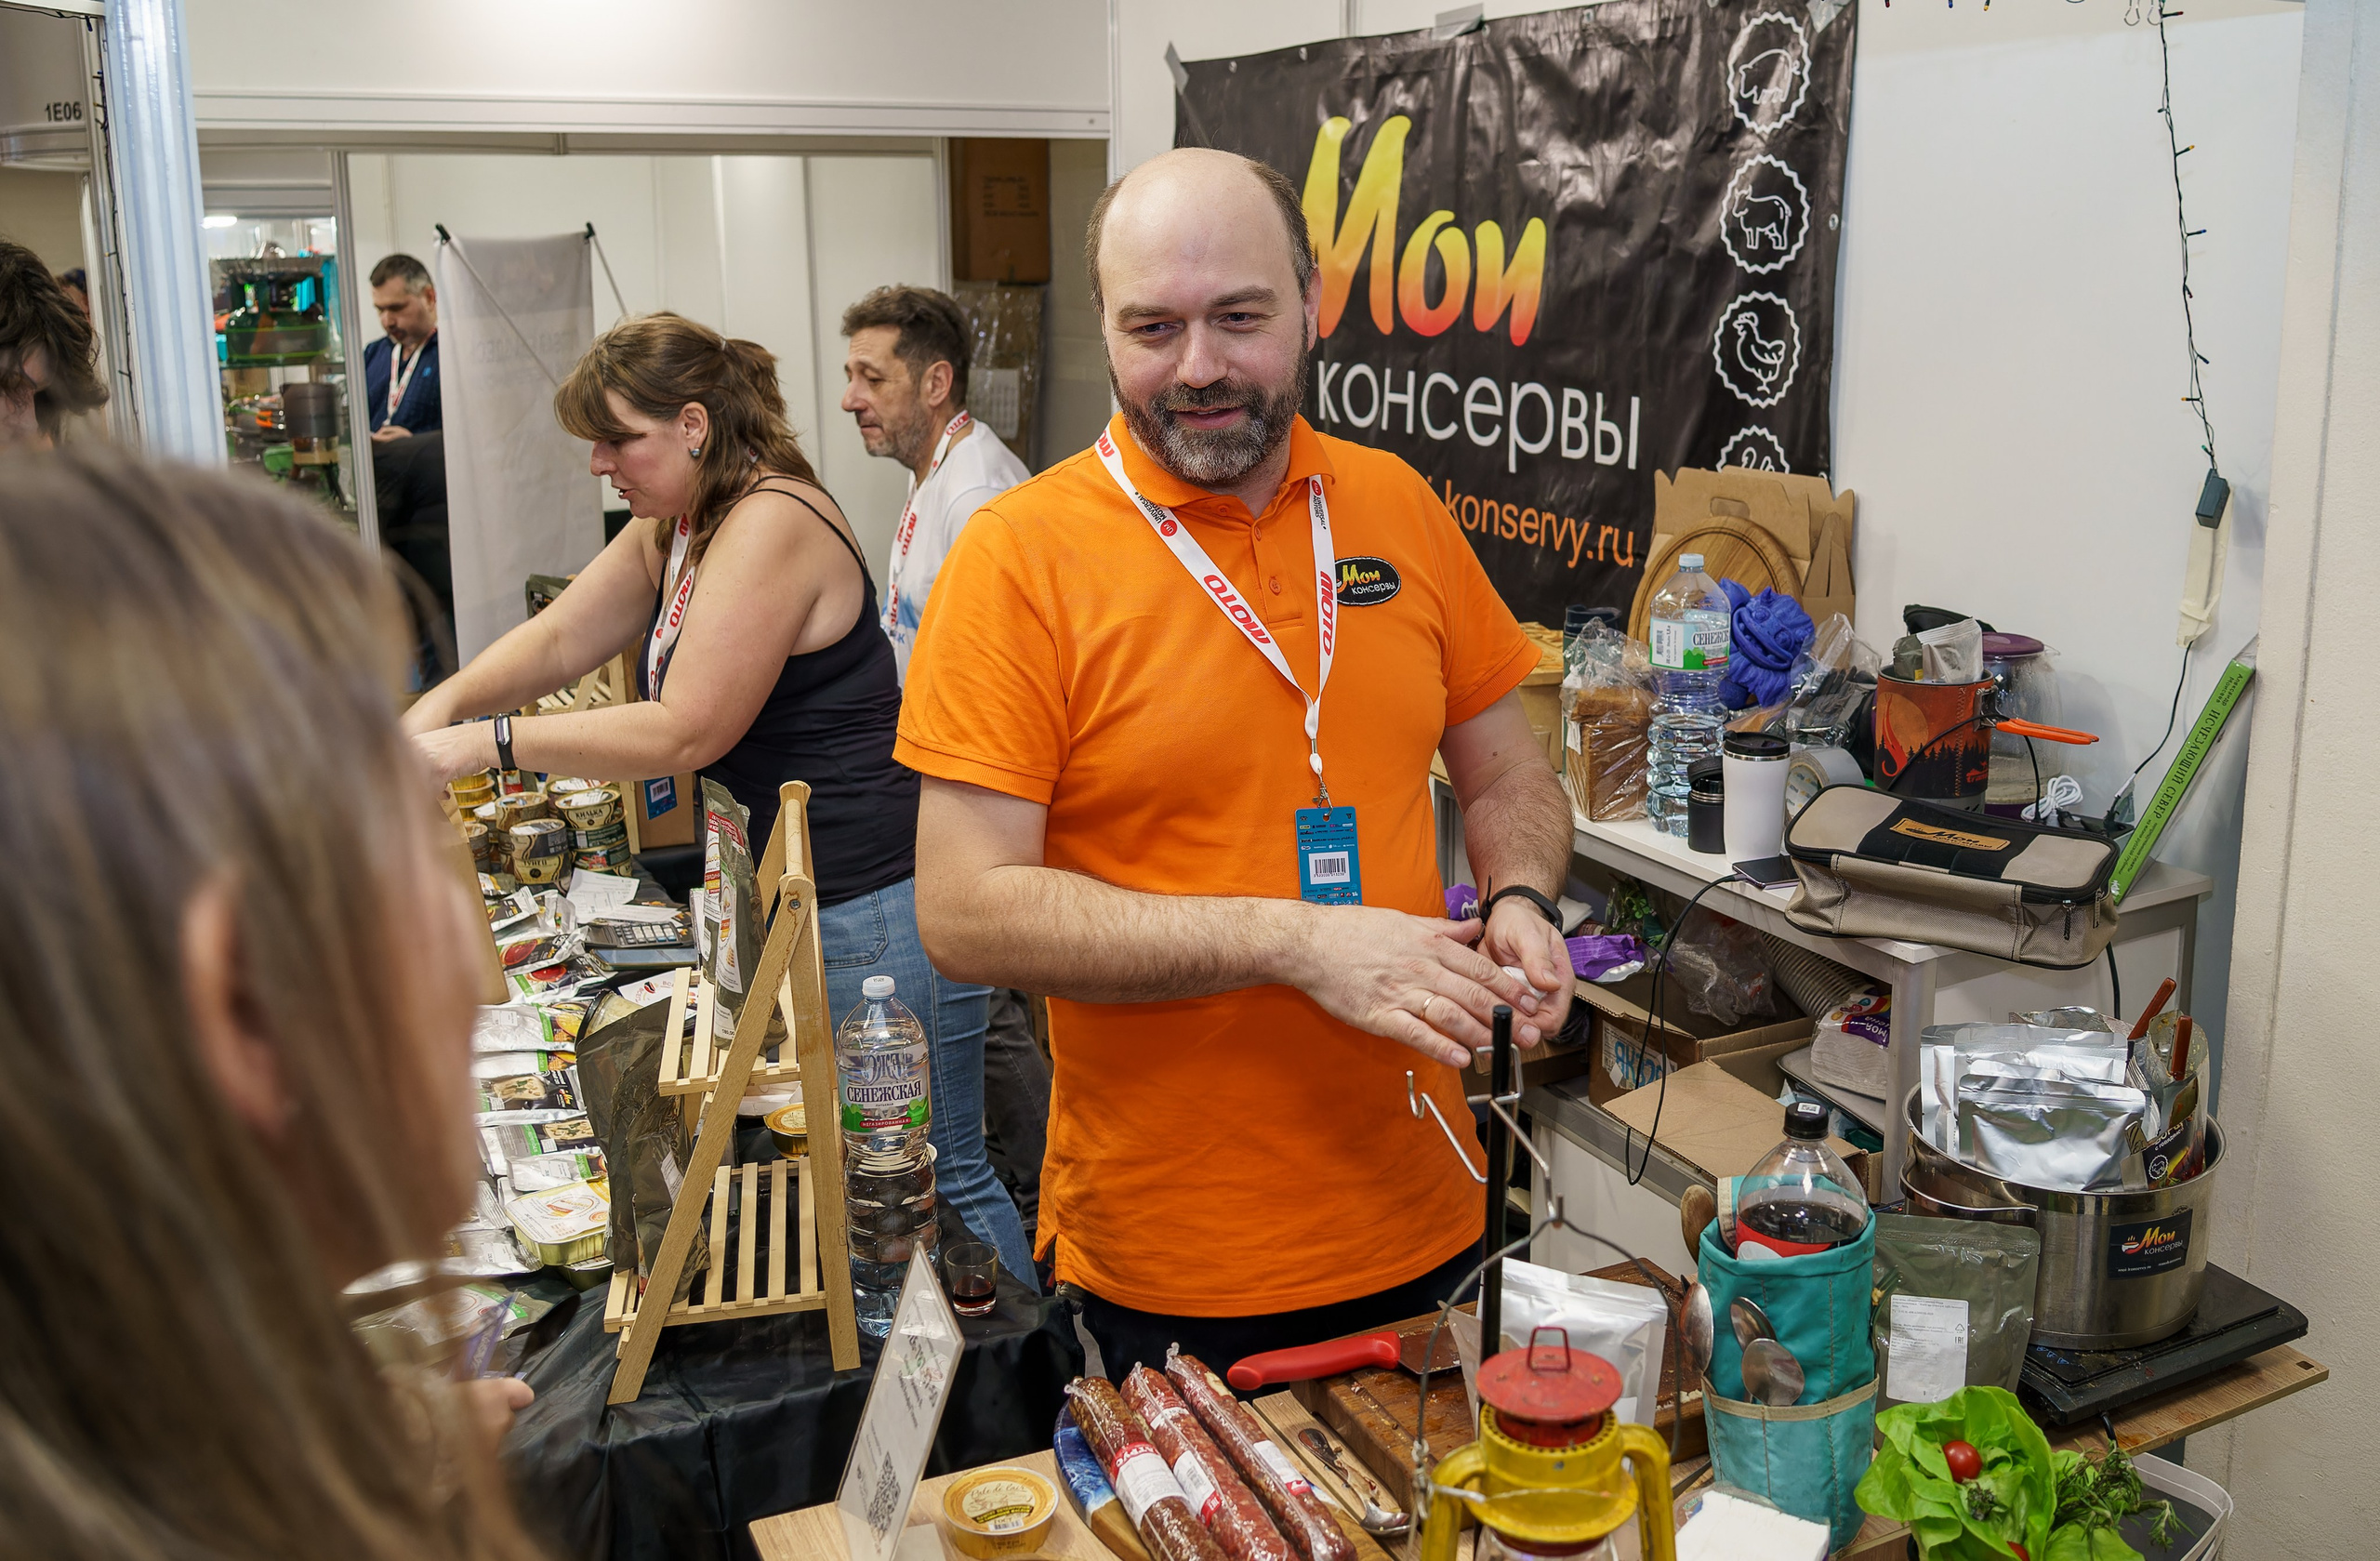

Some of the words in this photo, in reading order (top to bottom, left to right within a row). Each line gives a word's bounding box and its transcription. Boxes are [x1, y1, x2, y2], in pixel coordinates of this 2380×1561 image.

[45, 101, 82, 122] 1E06
[1317, 360, 1640, 473] консервы
[1342, 564, 1381, 585] Мои
[1351, 580, 1396, 595] консервы
[669, 574, 693, 628] MOTO
[1203, 574, 1271, 644] MOTO
[1319, 570, 1333, 656] MOTO
[2221, 673, 2243, 708] Александр
[2172, 708, 2220, 787] ИСЧЕЗАЮЩИЙ
[2152, 786, 2178, 821] СЕВЕР
[847, 1079, 922, 1103] СЕНЕЖСКАЯ
[862, 1118, 910, 1127] НЕГАЗИРОВАННАЯ
[2139, 1226, 2176, 1249] Мои
[2144, 1239, 2184, 1256] консервы
[1116, 1446, 1154, 1468] АТРУС
